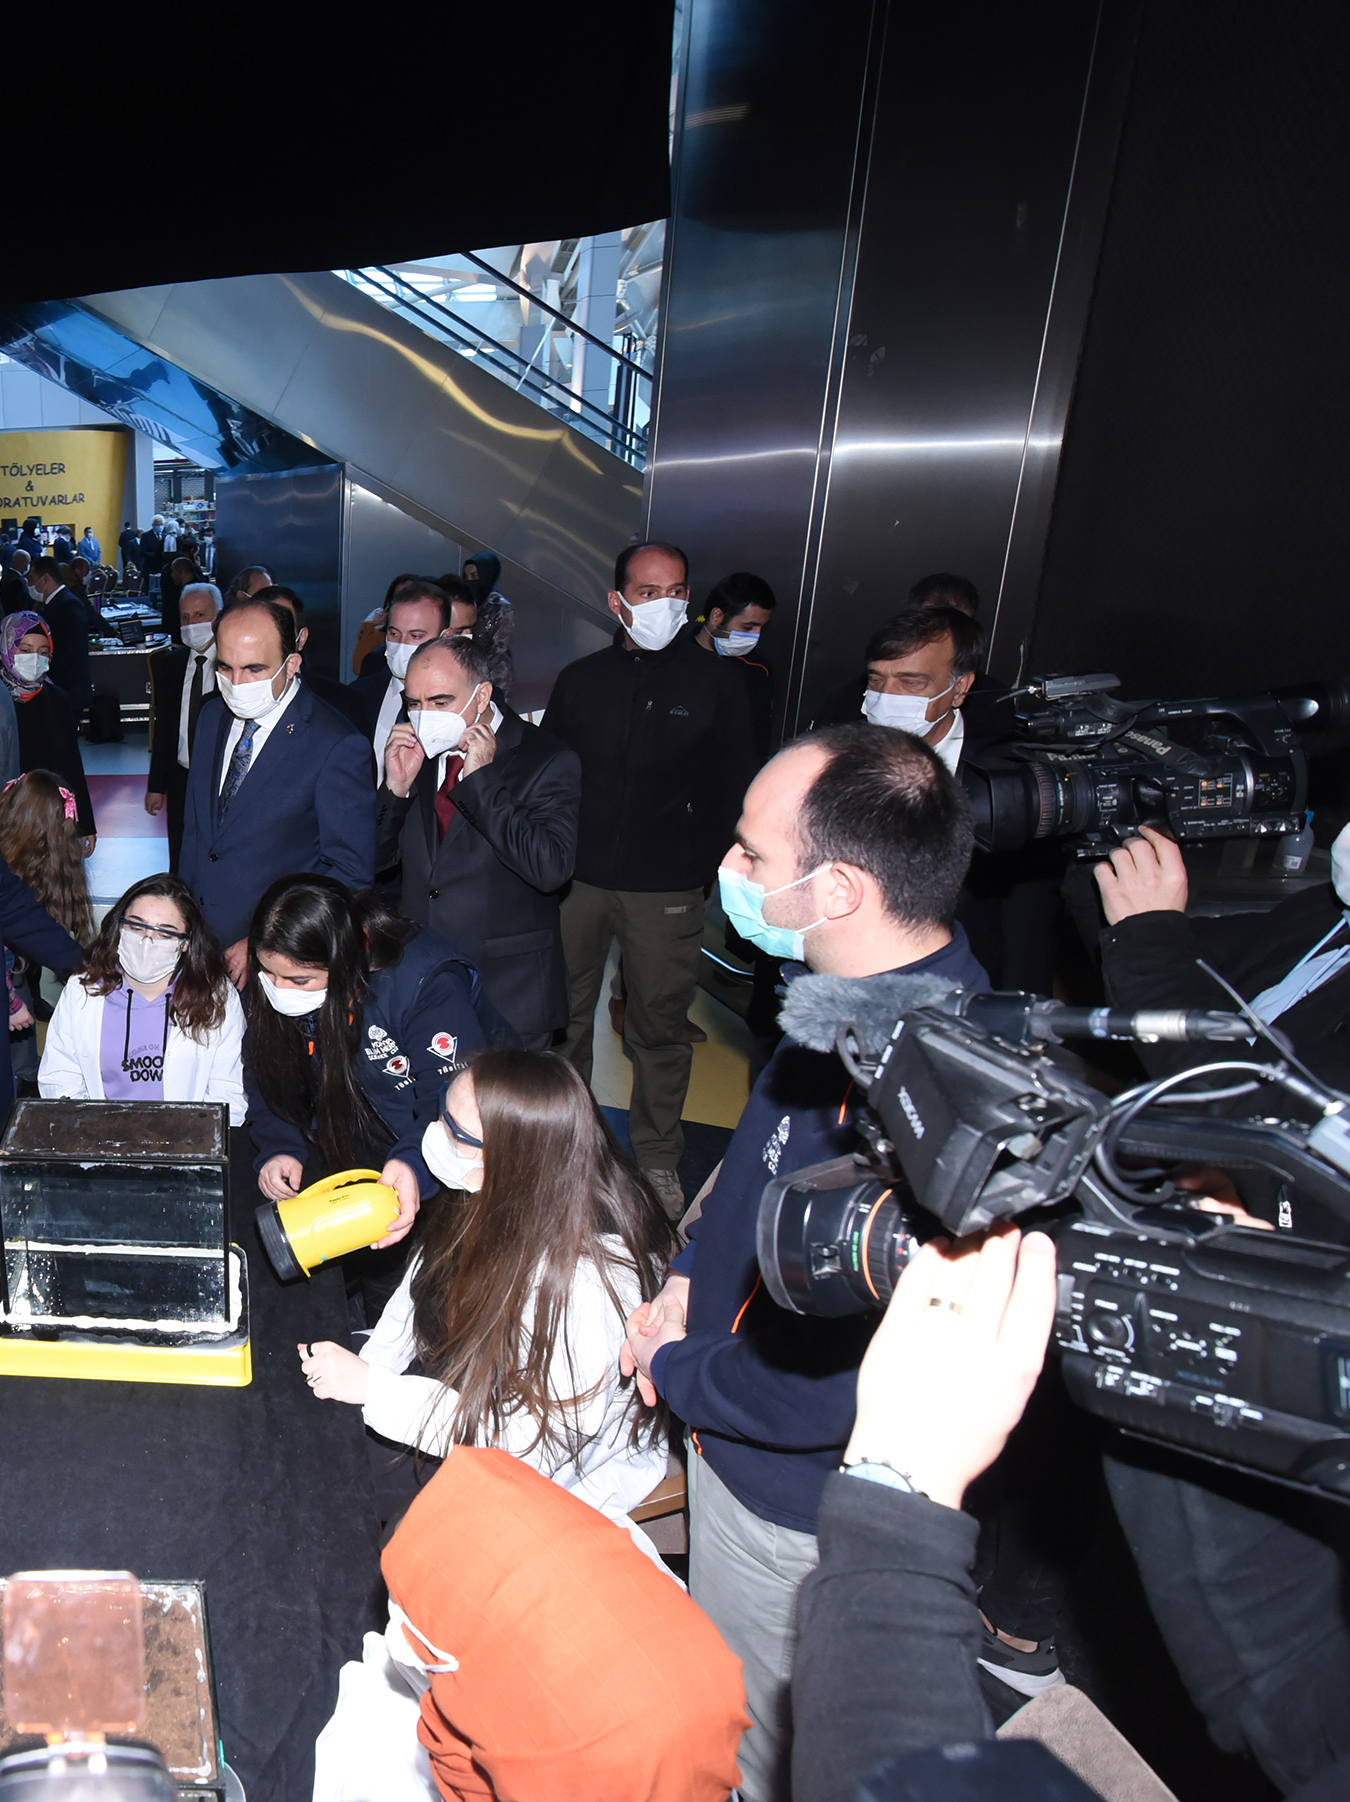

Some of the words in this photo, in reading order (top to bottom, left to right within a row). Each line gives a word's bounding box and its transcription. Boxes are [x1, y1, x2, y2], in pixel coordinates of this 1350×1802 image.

[25, 480, 34, 492] &
[121, 1055, 164, 1072] SMOO
[130, 1068, 164, 1082] DOW
